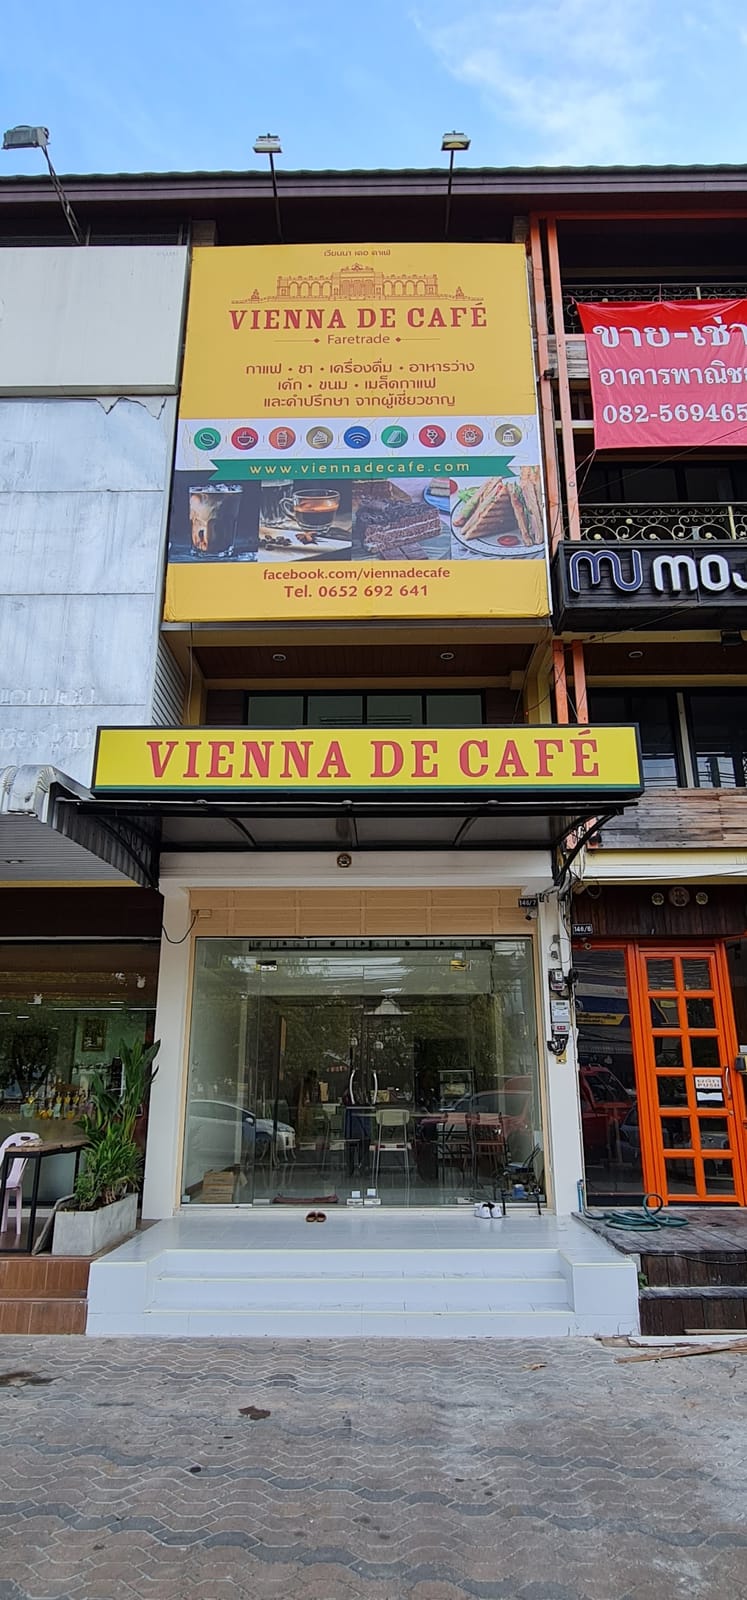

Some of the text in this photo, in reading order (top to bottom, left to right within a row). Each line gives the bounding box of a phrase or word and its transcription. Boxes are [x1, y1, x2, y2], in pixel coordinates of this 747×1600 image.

[229, 302, 488, 330] VIENNA DE CAFÉ
[327, 333, 391, 346] Faretrade
[246, 357, 475, 375] กาแฟ ชา เครื่องดื่ม อาหารว่าง
[599, 360, 747, 386] อาคารพาณิช
[278, 375, 436, 391] เค้ก ขนม เมล็ดกาแฟ
[264, 390, 456, 409] และคำปรึกษา จากผู้เชี่ยวชาญ
[250, 460, 470, 475] www.viennadecafe.com
[263, 566, 451, 581] facebook.com/viennadecafe
[284, 584, 428, 598] Tel. 0652 692 641
[146, 729, 600, 779] VIENNA DE CAFÉ
